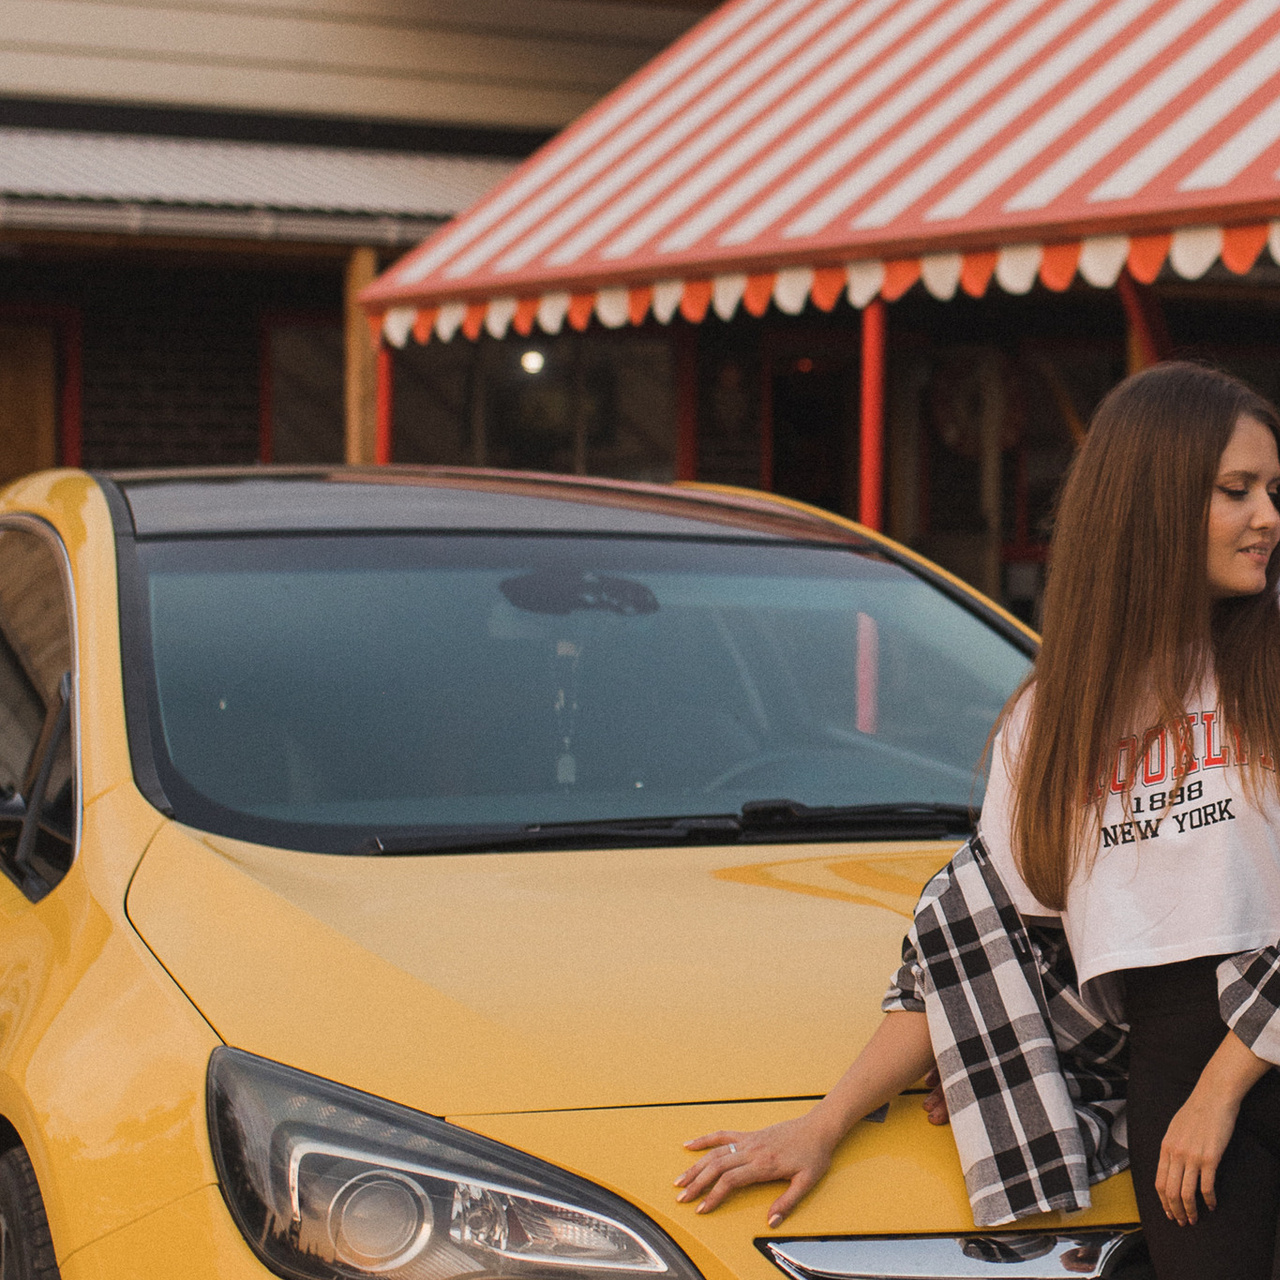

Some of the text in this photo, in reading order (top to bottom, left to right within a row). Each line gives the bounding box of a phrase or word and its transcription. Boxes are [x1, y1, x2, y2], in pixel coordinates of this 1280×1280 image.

[1132, 780, 1204, 814] 1898
[1101, 798, 1236, 848] NEW YORK
